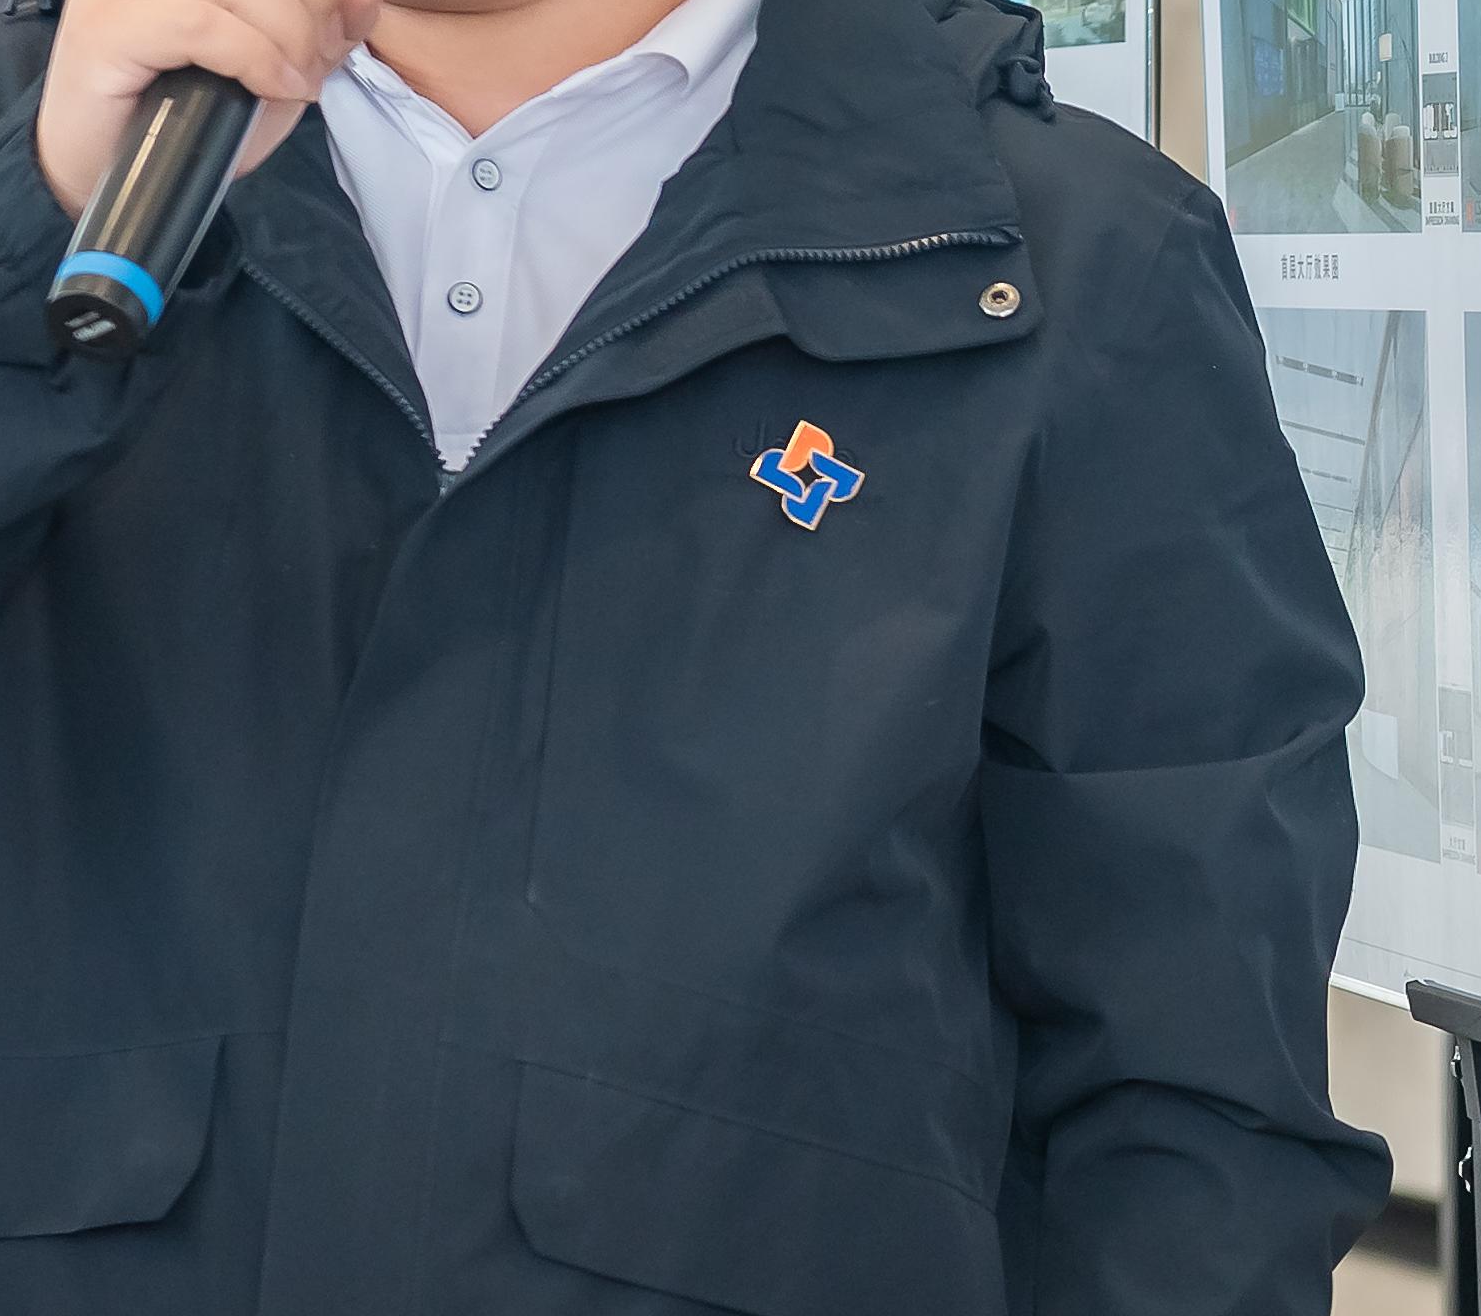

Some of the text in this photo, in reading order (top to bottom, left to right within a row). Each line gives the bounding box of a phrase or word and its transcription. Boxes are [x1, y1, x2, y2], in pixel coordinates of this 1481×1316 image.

[1280, 253, 1340, 281] 首层大厅效果图
